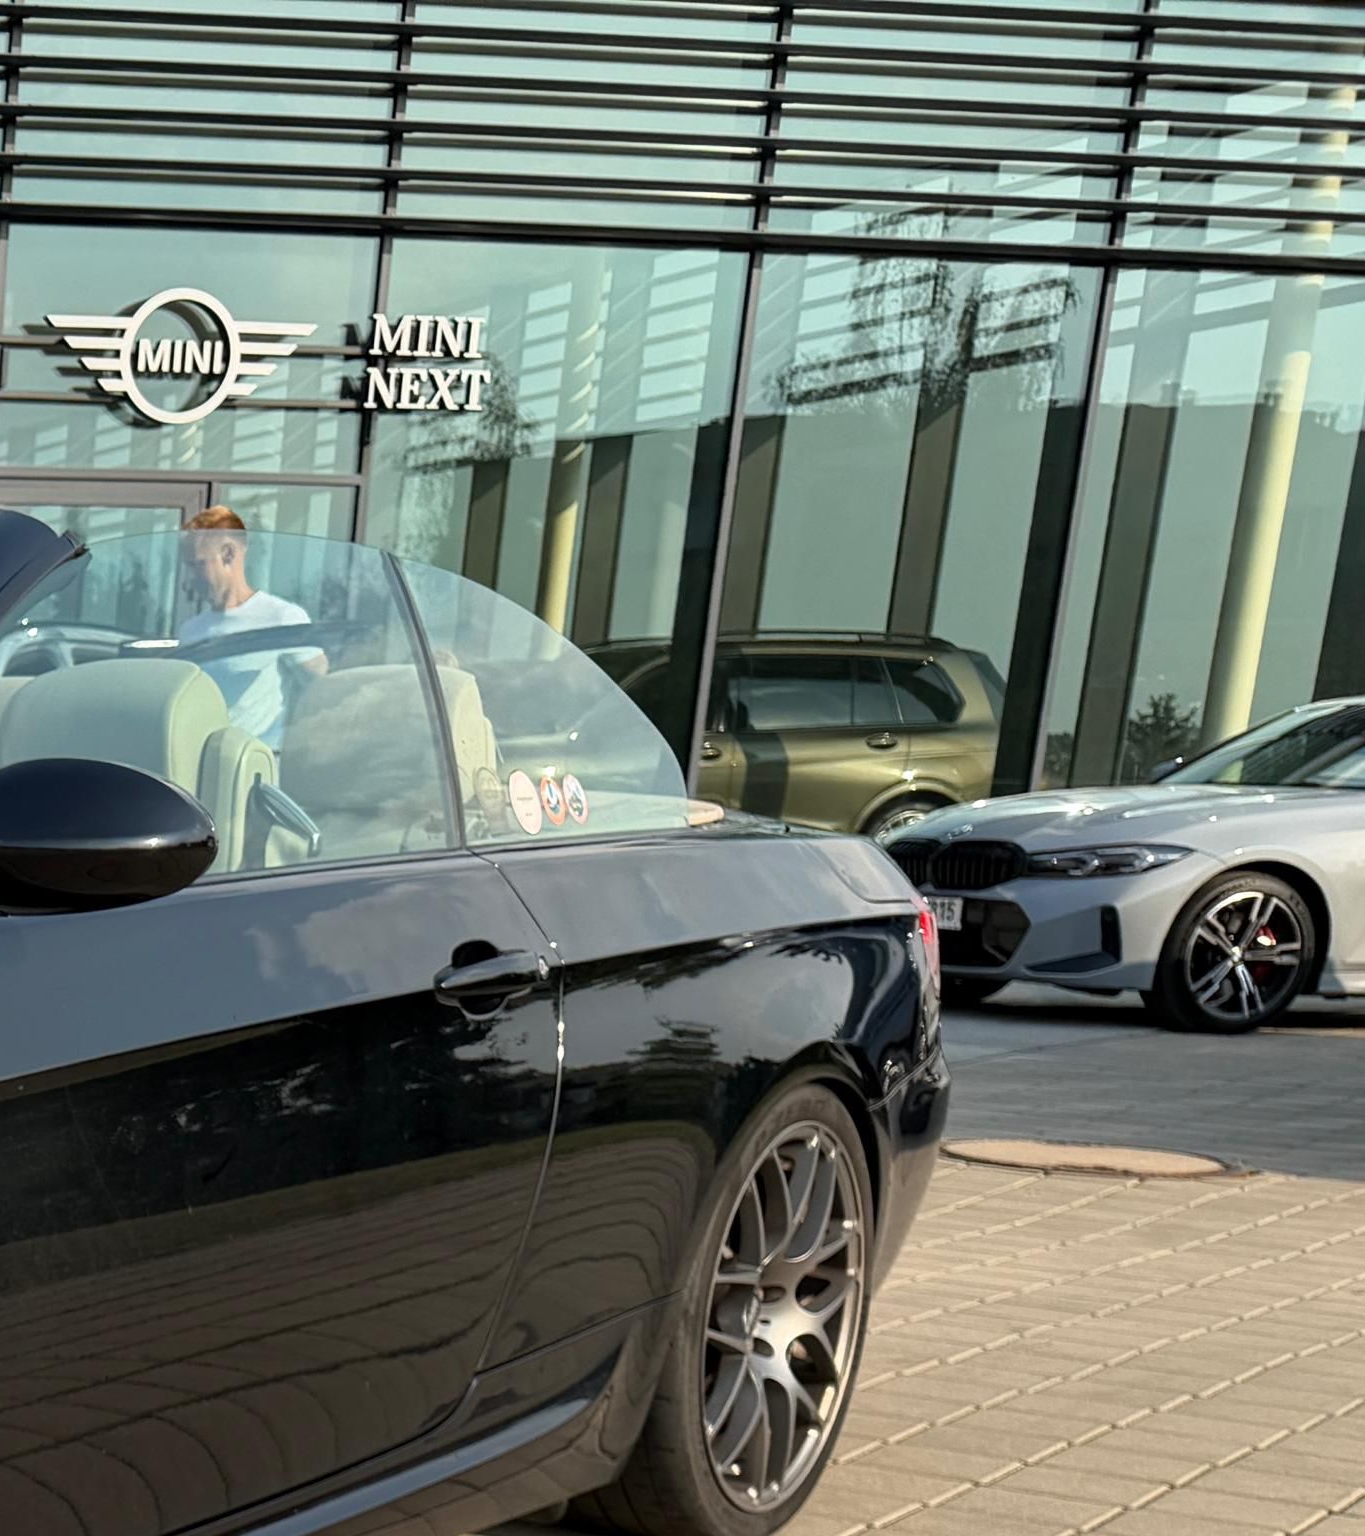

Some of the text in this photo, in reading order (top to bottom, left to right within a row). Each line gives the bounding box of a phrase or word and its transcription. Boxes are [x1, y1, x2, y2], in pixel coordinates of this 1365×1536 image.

[136, 337, 225, 375] MINI
[369, 313, 486, 359] MINI
[363, 366, 491, 411] NEXT
